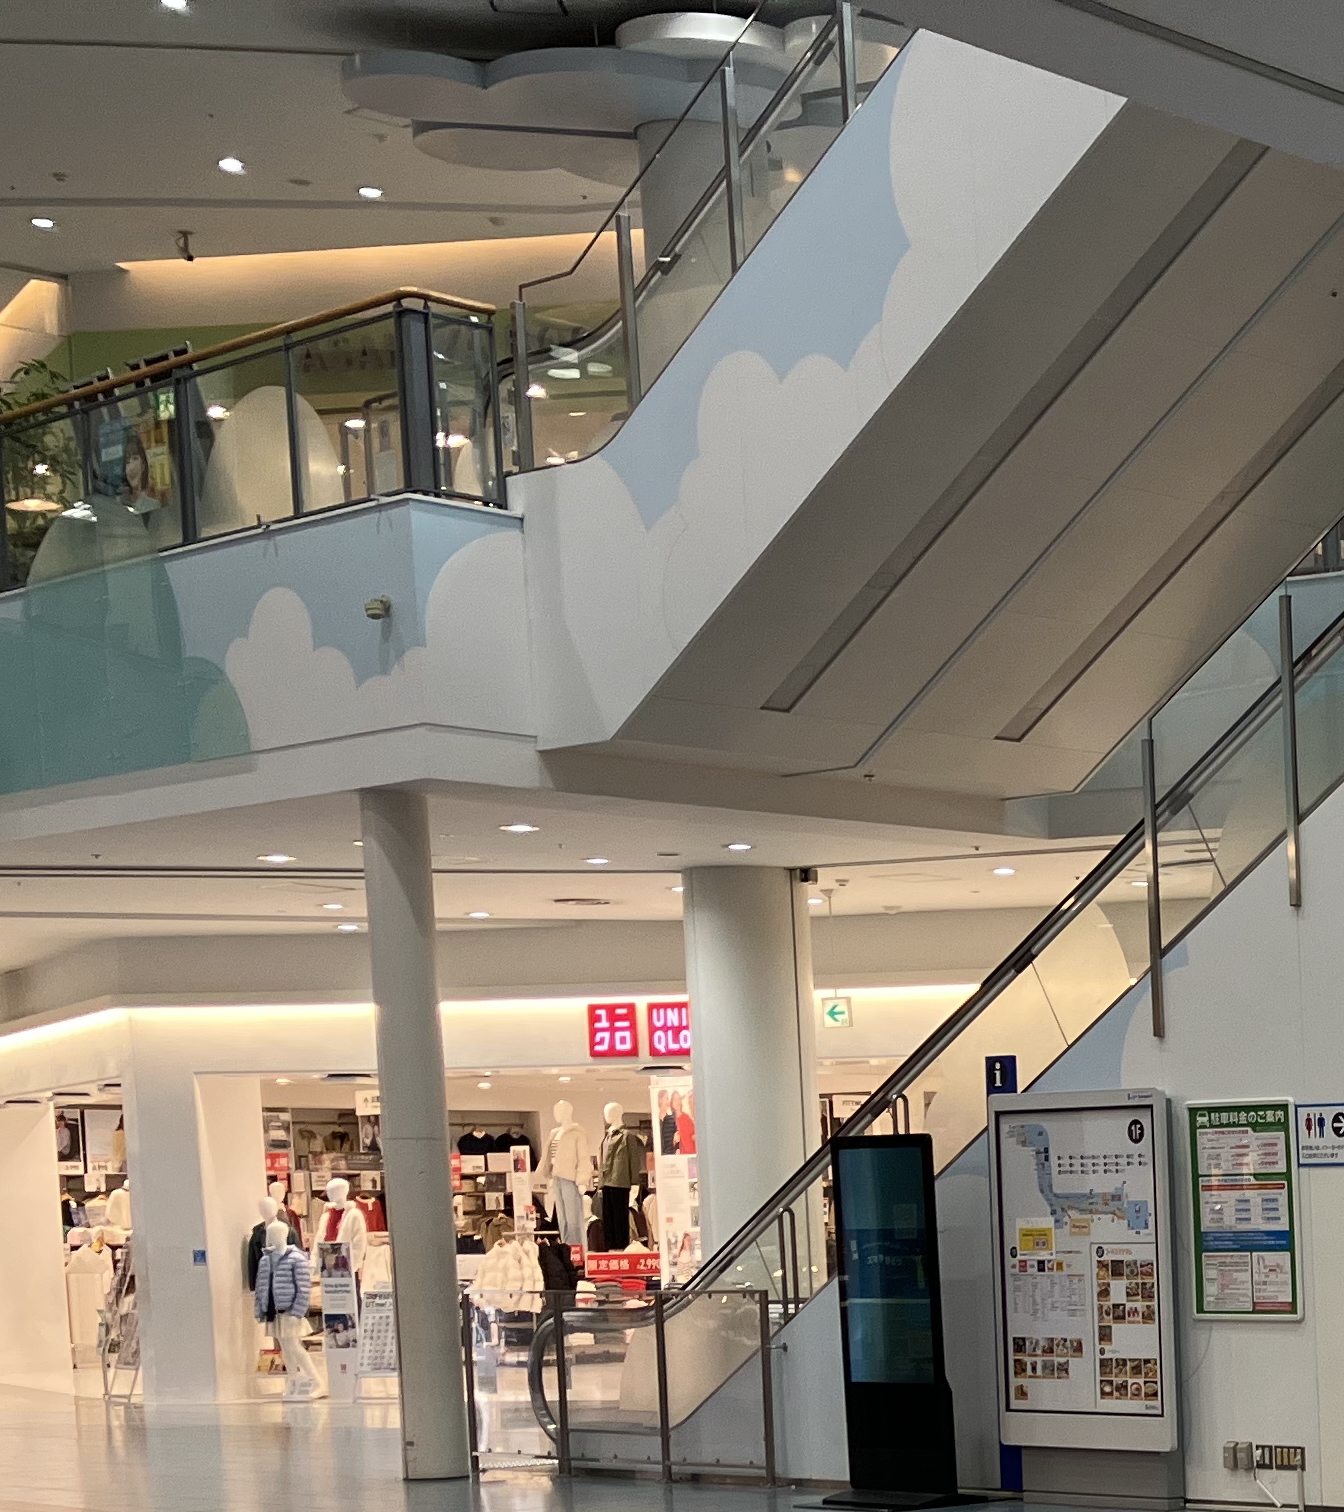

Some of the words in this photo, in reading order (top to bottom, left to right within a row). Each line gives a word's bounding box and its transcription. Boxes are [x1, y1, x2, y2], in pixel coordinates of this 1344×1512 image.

[652, 1007, 688, 1028] UNI
[593, 1031, 632, 1051] クロ
[653, 1029, 691, 1053] QLO
[1210, 1109, 1285, 1126] 駐車料金のご案内
[1130, 1123, 1142, 1140] 1F
